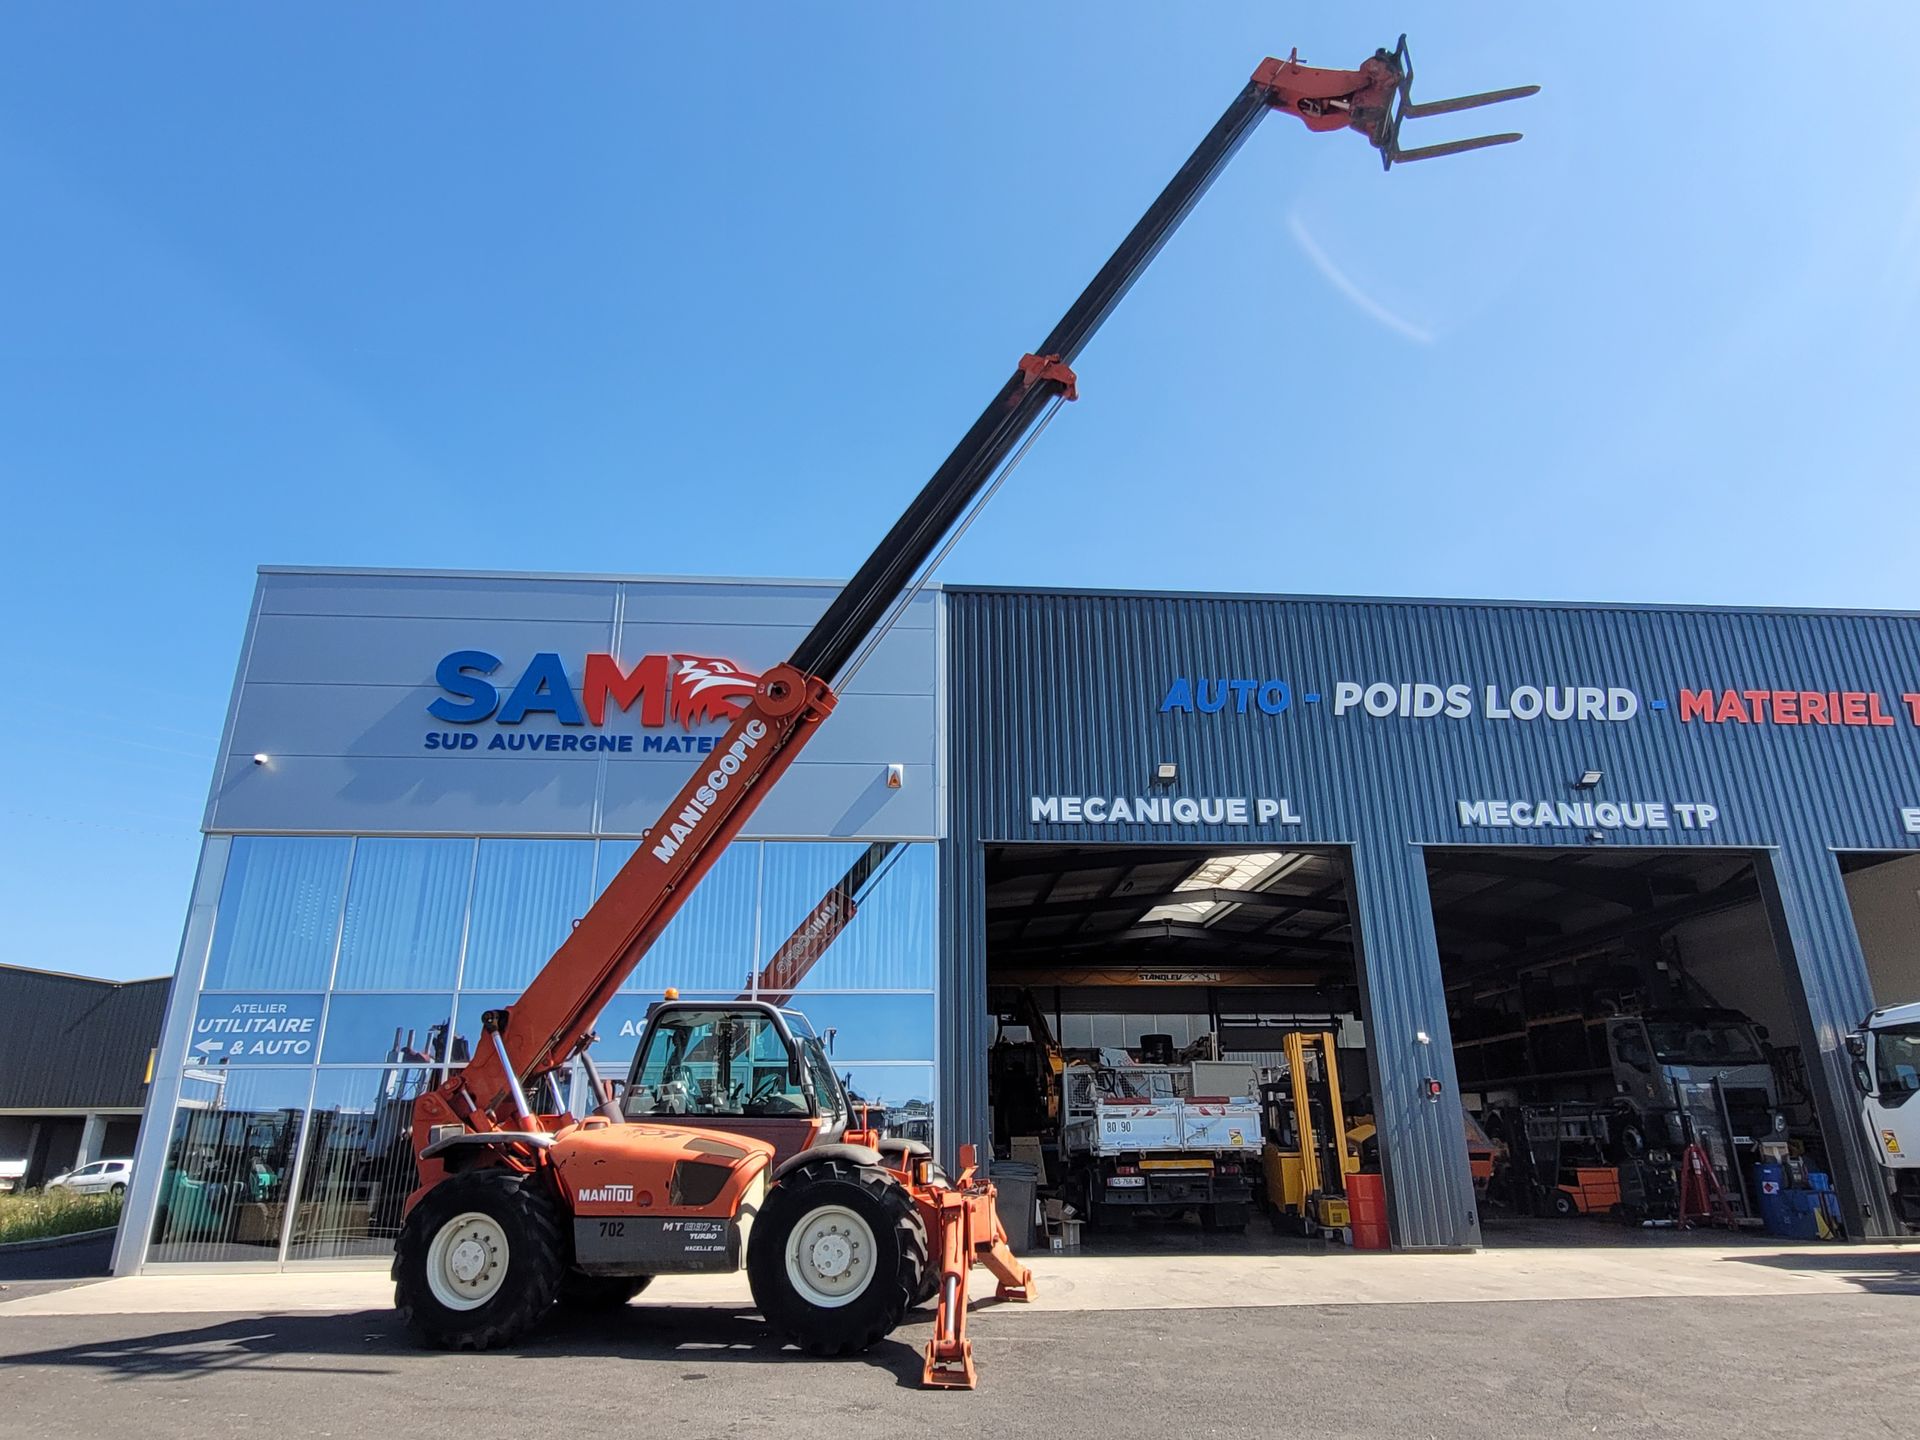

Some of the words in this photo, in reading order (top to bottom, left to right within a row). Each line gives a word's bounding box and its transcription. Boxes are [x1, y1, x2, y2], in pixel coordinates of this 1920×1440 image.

[426, 650, 671, 728] SAM
[1159, 678, 1291, 716] AUTO
[1334, 682, 1472, 719] POIDS
[1486, 685, 1638, 721] LOURD
[1680, 689, 1895, 727] MATERIEL
[424, 732, 478, 751] SUD
[488, 733, 633, 753] AUVERGNE
[651, 719, 768, 864] MANISCOPIC
[1031, 796, 1249, 824] MECANIQUE
[1259, 799, 1301, 824] PL
[1458, 801, 1669, 829] MECANIQUE
[1675, 804, 1718, 829] TP
[232, 1004, 287, 1014] ATELIER
[197, 1018, 315, 1033] UTILITAIRE
[229, 1040, 244, 1055] &
[248, 1039, 311, 1055] AUTO
[1106, 1121, 1117, 1133] 80
[1121, 1121, 1131, 1132] 90
[578, 1185, 634, 1202] MANITOU
[599, 1222, 624, 1237] 702
[662, 1222, 684, 1232] MT
